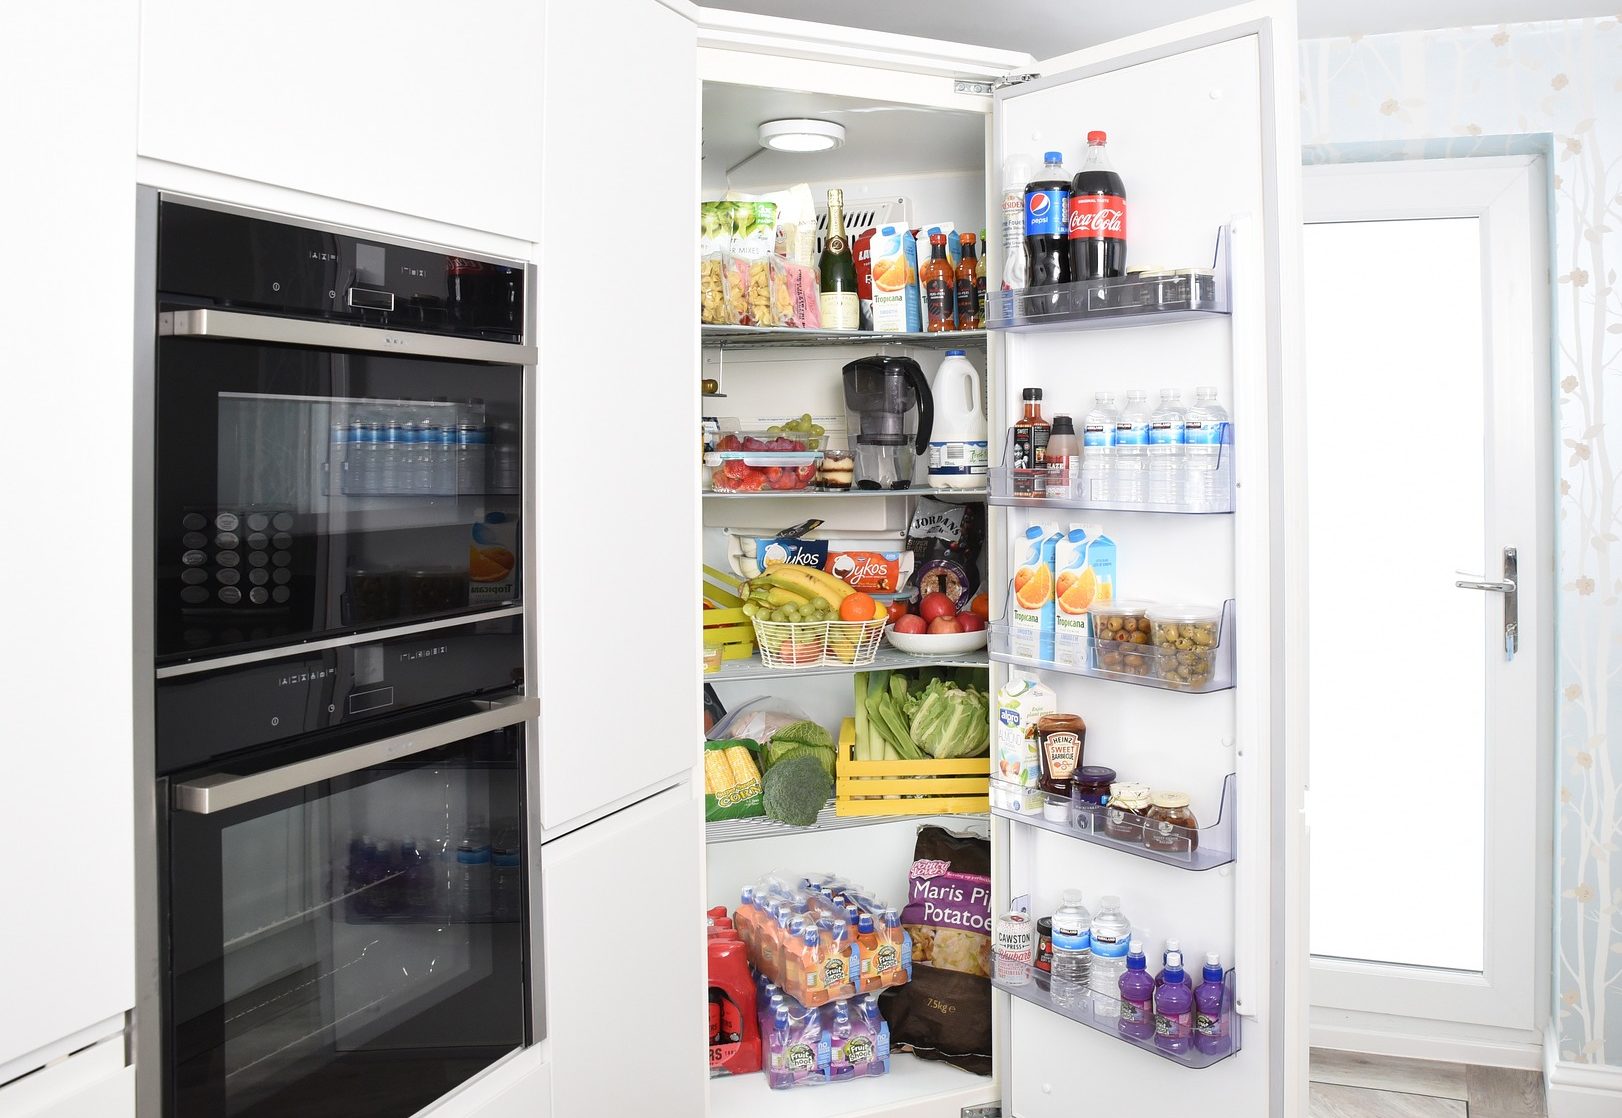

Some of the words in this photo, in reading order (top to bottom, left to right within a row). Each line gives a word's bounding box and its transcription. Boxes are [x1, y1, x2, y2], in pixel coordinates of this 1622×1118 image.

[1031, 216, 1049, 225] pepsi
[1069, 208, 1124, 233] Coca-Cola
[874, 295, 903, 304] Tropicana
[914, 515, 961, 536] JORDANS
[832, 554, 888, 585] Oykos
[1014, 609, 1039, 623] Tropicana
[1056, 615, 1085, 628] Tropicana
[1001, 710, 1019, 723] alpro
[1052, 736, 1073, 744] HEINZ
[719, 784, 762, 807] CORN
[914, 880, 964, 902] Maris
[924, 902, 991, 931] Potatoe
[998, 932, 1031, 944] CAWSTON
[879, 952, 896, 964] Fruit
[825, 965, 843, 977] Fruit
[878, 959, 898, 972] Shoot
[824, 972, 845, 985] Shoot
[926, 997, 948, 1014] 7.5kg
[850, 1043, 869, 1054] Fruit
[791, 1050, 811, 1061] Fruit
[849, 1050, 872, 1062] Shoot
